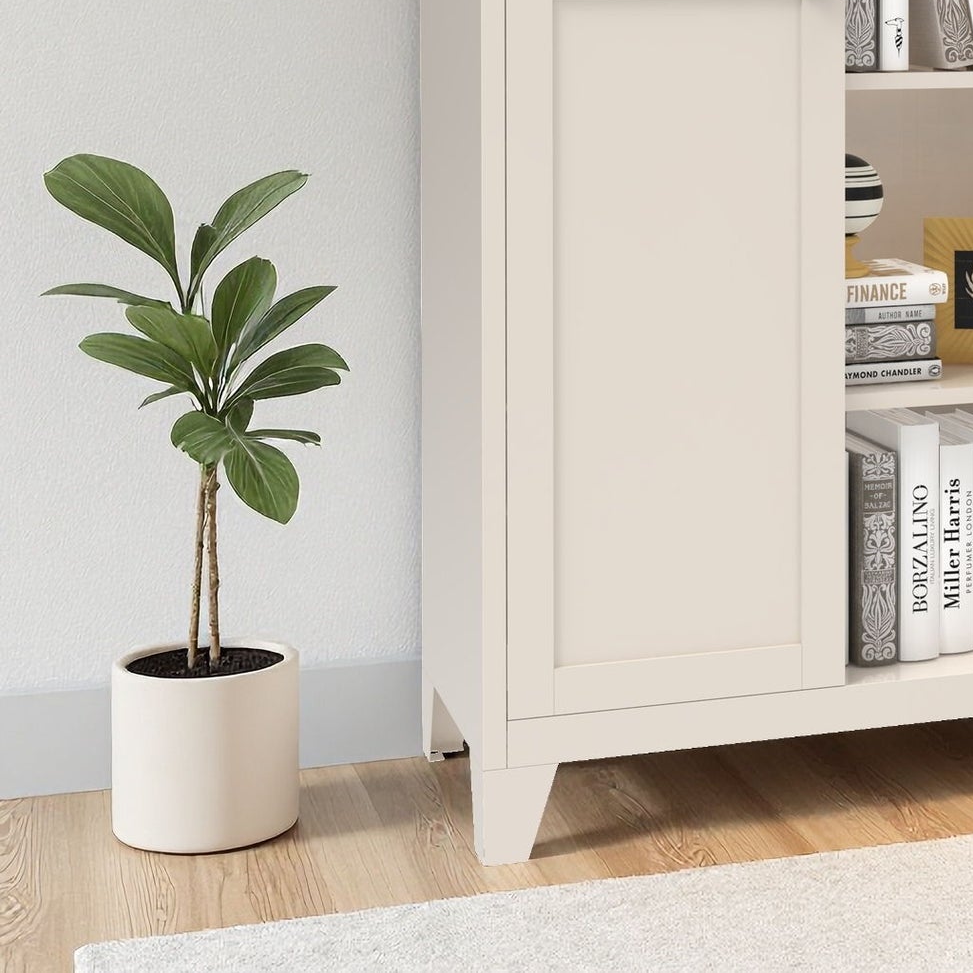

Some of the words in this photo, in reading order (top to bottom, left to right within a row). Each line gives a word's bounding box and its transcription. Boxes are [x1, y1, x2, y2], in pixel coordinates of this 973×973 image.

[847, 282, 908, 303] FINANCE
[878, 311, 902, 320] AUTHOR
[905, 310, 922, 318] NAME
[881, 367, 922, 378] CHANDLER
[865, 482, 893, 490] MEMOIR
[943, 478, 961, 543] Harris
[965, 490, 973, 536] LONDON
[912, 484, 929, 614] BORZALINO
[965, 541, 973, 594] PERFUMER
[943, 548, 961, 609] Miller
